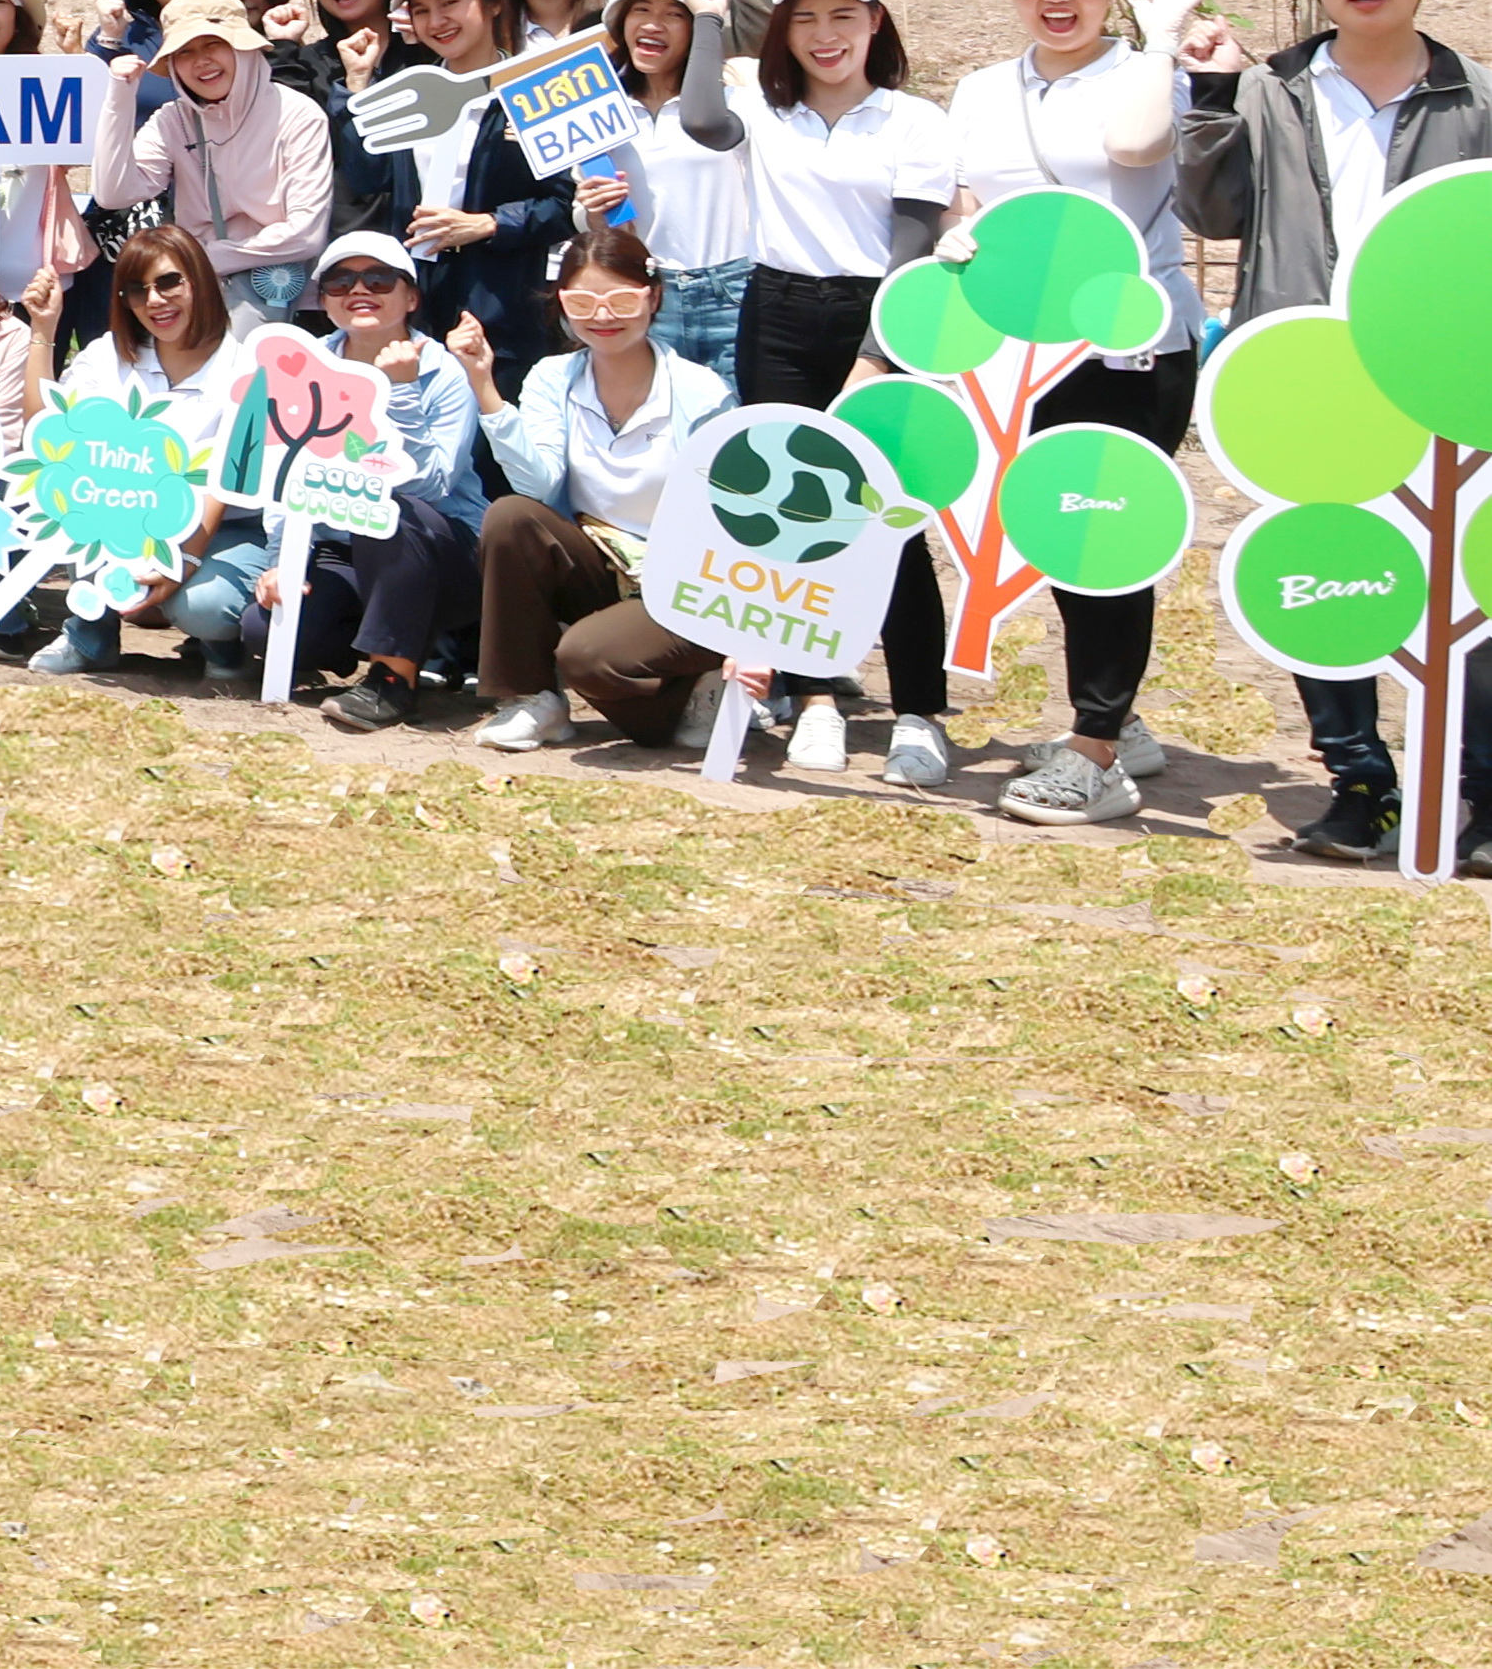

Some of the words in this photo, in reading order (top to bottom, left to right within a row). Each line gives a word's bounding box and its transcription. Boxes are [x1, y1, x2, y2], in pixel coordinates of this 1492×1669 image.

[511, 62, 610, 122] บสก
[532, 102, 627, 164] BAM
[84, 440, 155, 475] Think
[70, 475, 159, 510] Green
[286, 479, 392, 532] trees
[304, 462, 385, 502] save
[1058, 492, 1127, 513] Bam
[699, 548, 837, 618] LOVE
[1277, 570, 1398, 611] Bam
[670, 580, 843, 662] EARTH
